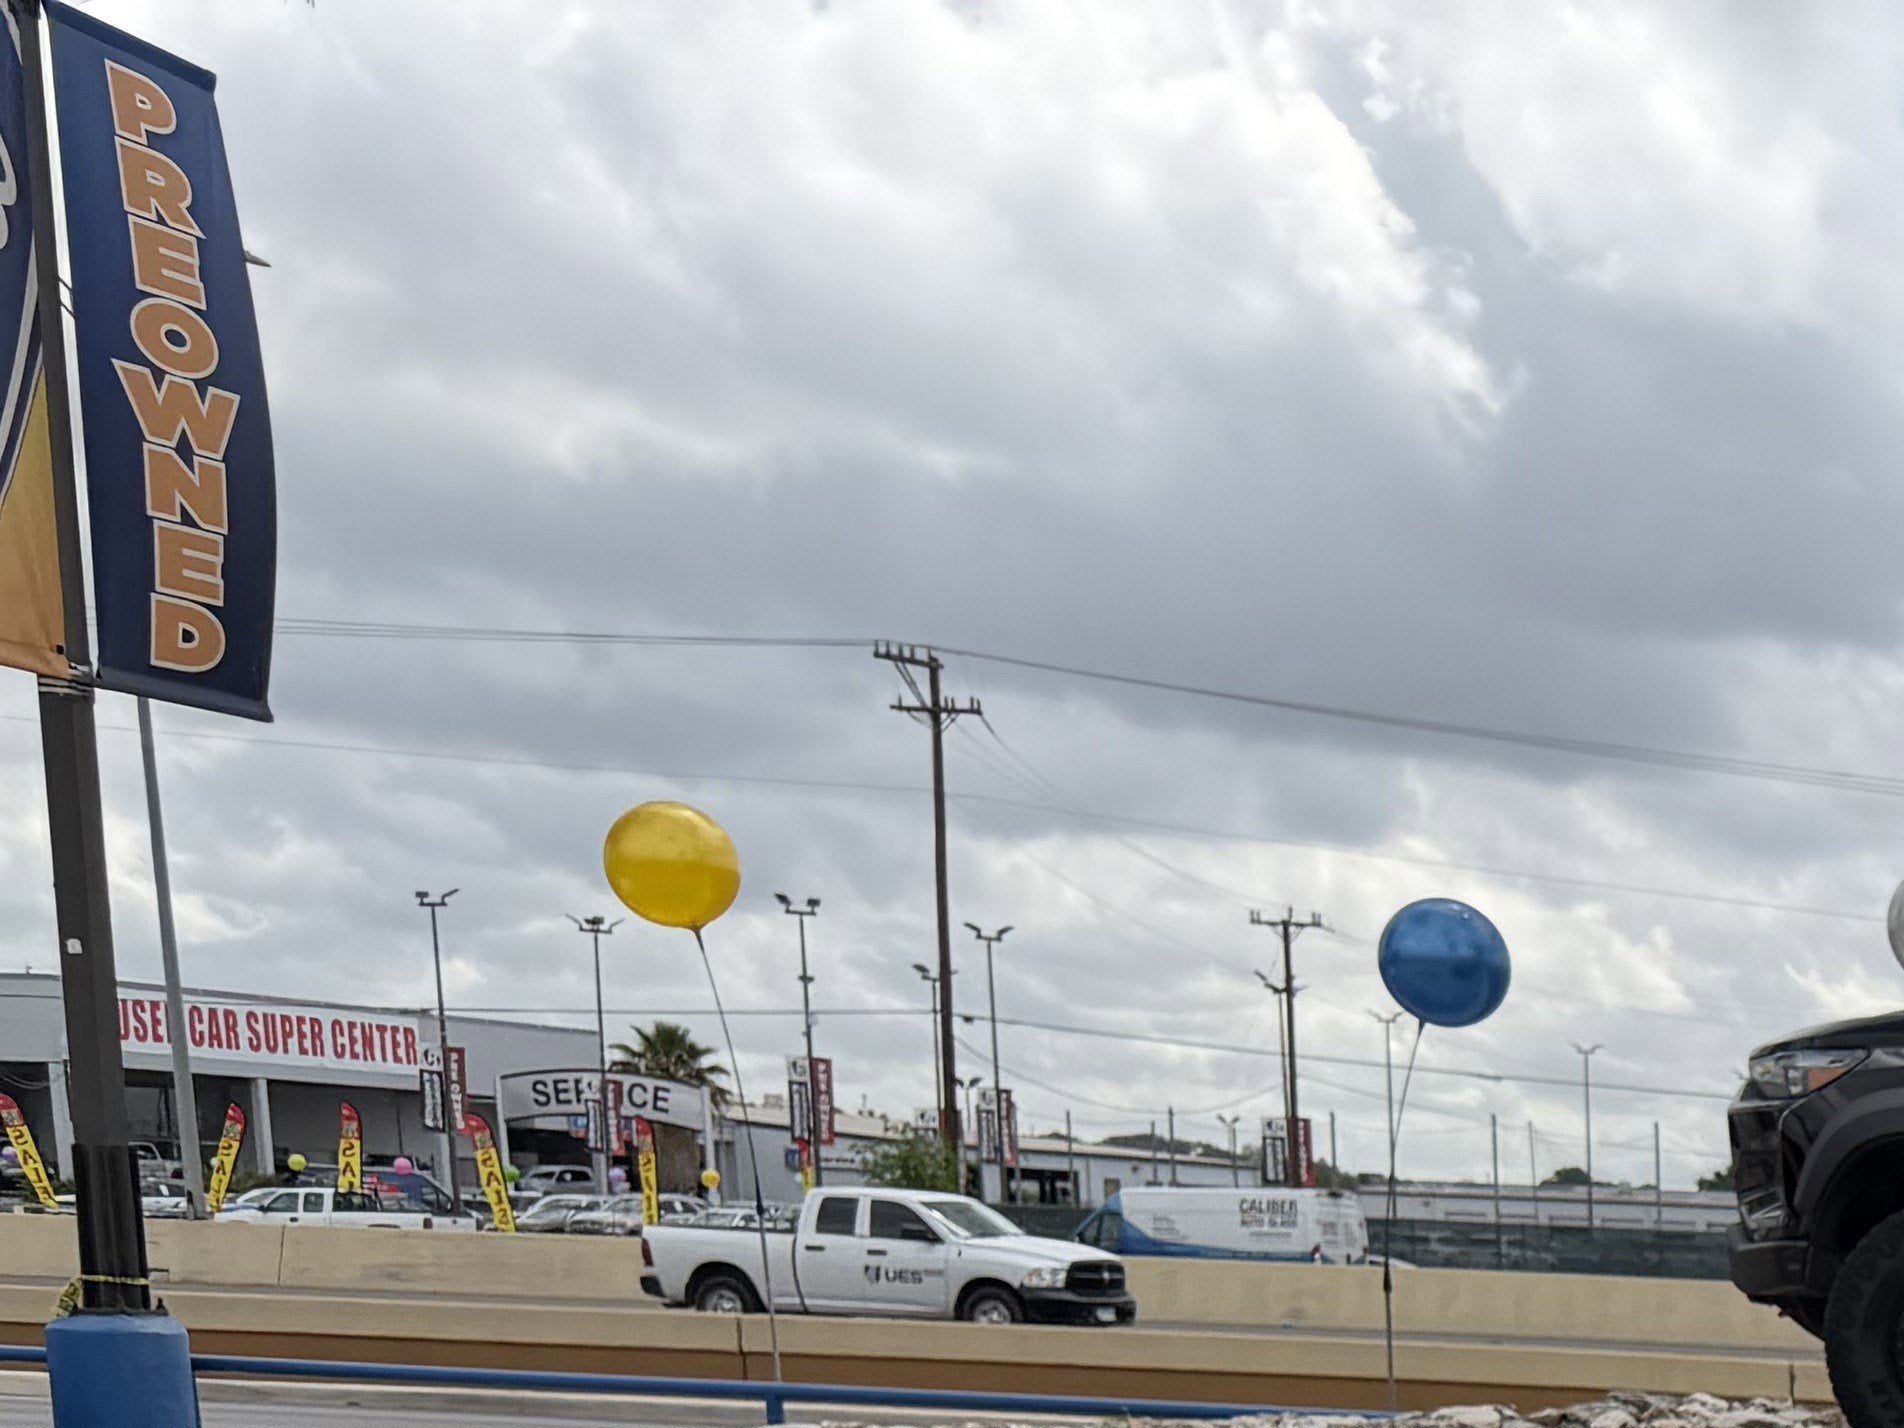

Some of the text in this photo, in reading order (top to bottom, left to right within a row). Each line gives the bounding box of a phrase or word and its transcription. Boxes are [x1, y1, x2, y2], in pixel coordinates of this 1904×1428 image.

[104, 58, 241, 673] PREOWNED
[188, 1004, 241, 1051] CAR
[246, 1009, 326, 1057] SUPER
[330, 1018, 419, 1066] CENTER
